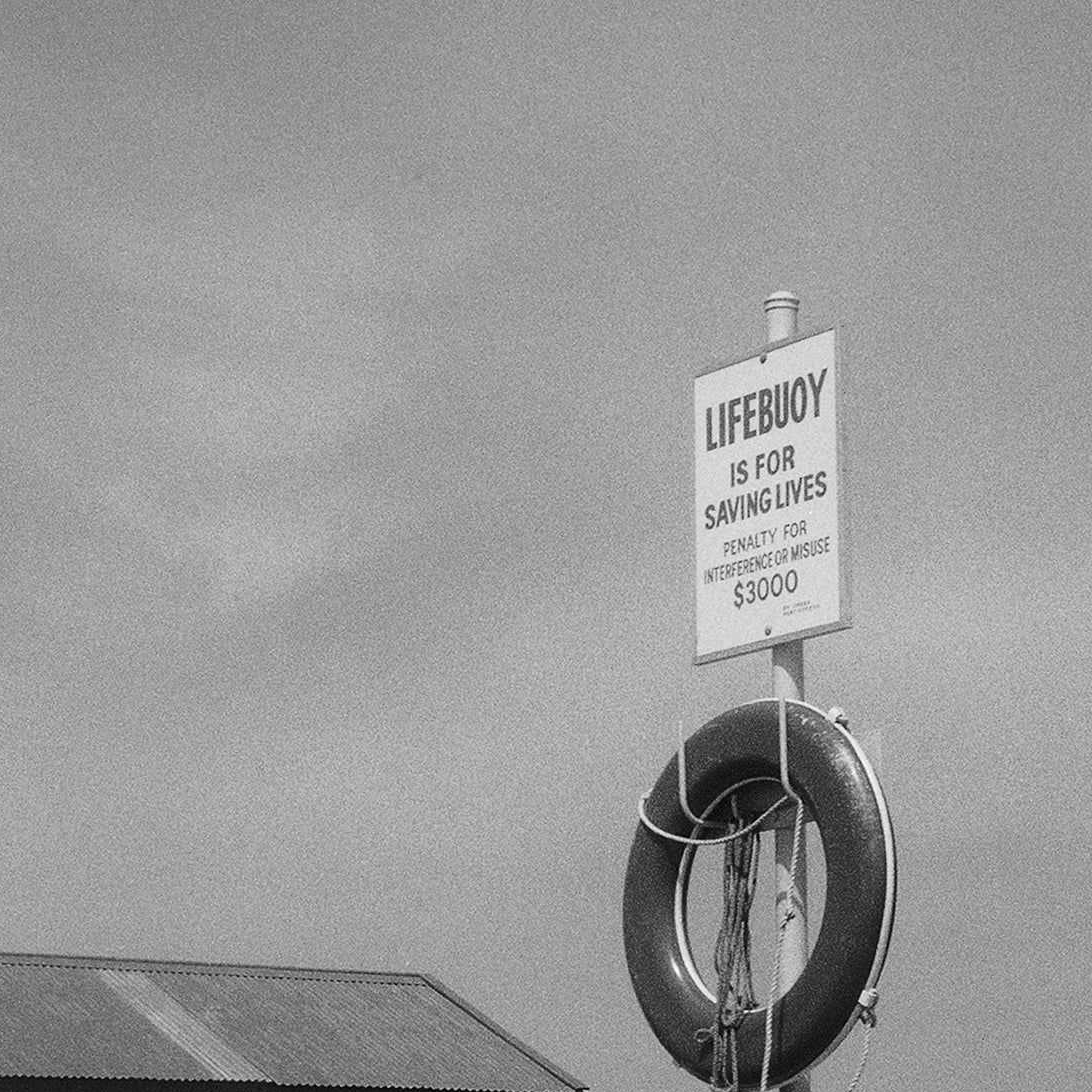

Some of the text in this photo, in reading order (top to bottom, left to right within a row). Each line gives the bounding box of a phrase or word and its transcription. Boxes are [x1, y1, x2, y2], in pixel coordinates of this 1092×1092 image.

[706, 367, 828, 452] LIFEBUOY
[730, 444, 795, 488] IS FOR
[704, 470, 827, 530] SAVING LIVES
[704, 535, 831, 585] INTERFERENCE OR MISUSE
[723, 520, 807, 557] PENALTY FOR
[733, 569, 798, 610] $3000
